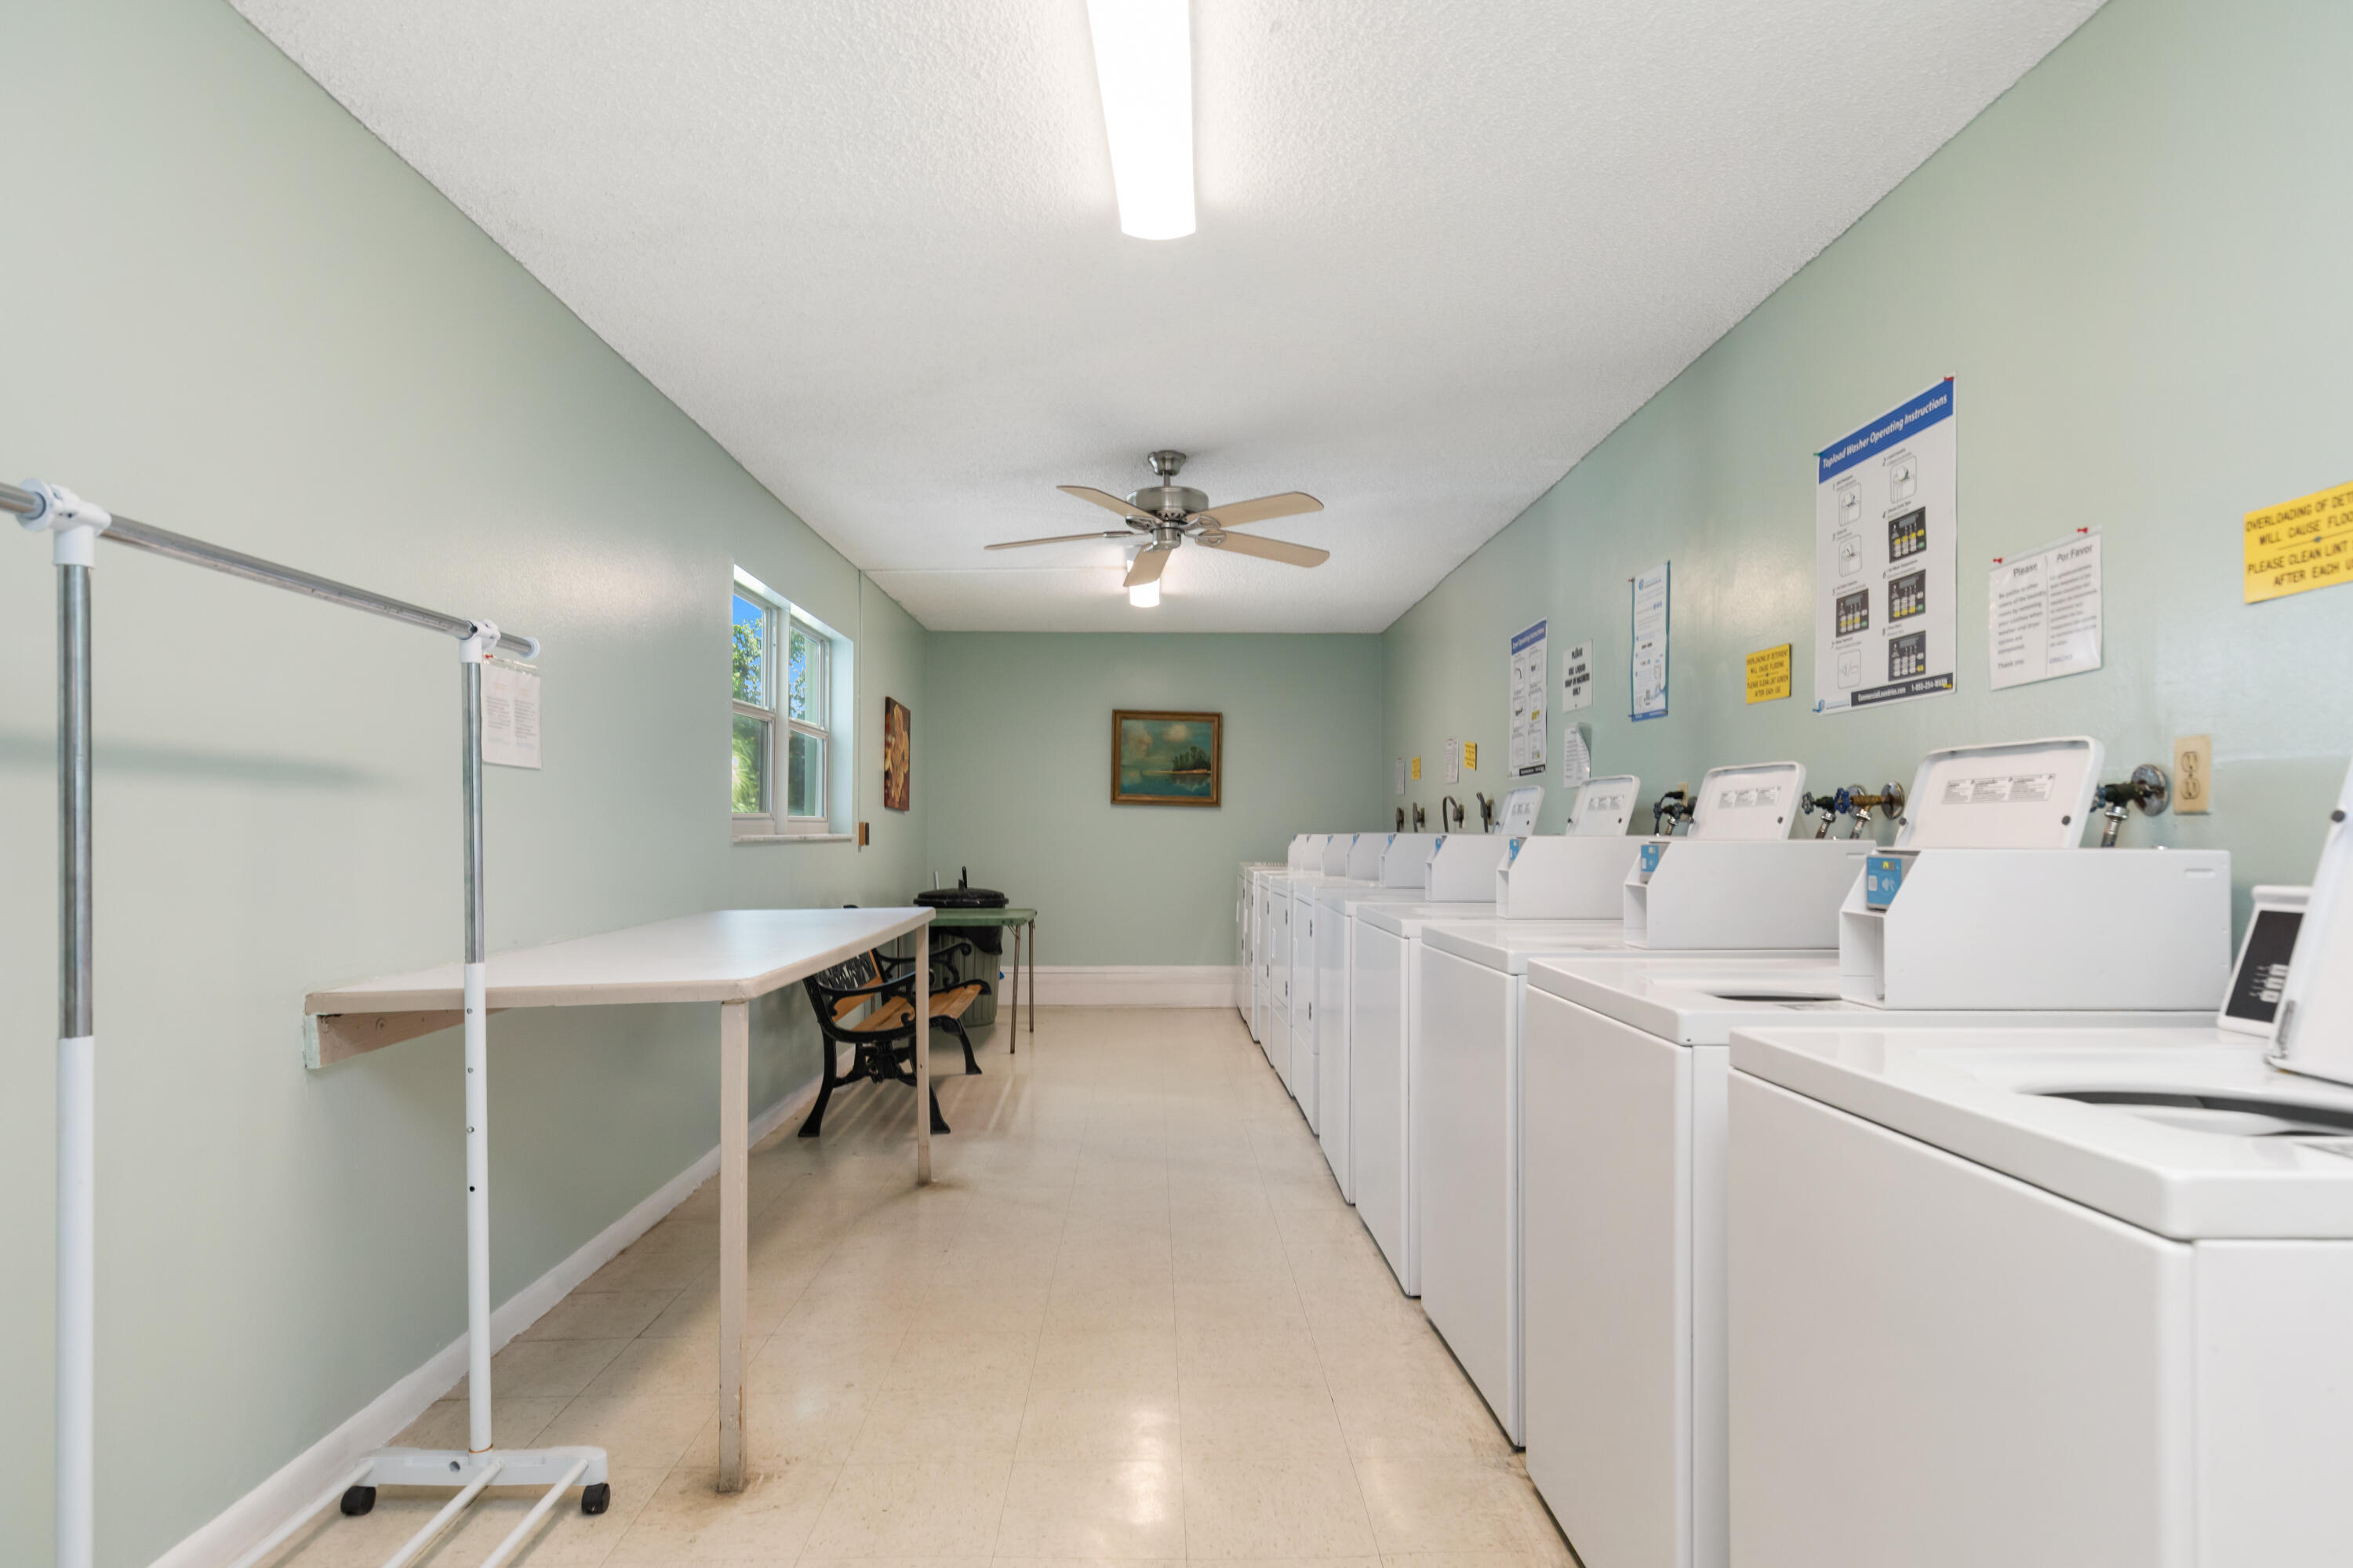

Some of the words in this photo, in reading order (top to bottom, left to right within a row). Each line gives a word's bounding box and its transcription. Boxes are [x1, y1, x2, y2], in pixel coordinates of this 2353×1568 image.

[1823, 447, 1847, 469] Topload
[1846, 437, 1869, 456] Washer
[1870, 417, 1904, 444] Operating
[1904, 394, 1947, 424] Instructions
[2246, 504, 2312, 532] OVERLOADING
[2315, 498, 2328, 513] OF
[2260, 532, 2282, 545] WILL
[2288, 519, 2322, 538] CAUSE
[2057, 552, 2069, 562] Por
[2071, 544, 2093, 558] Favor
[2248, 556, 2285, 574] PLEASE
[2289, 548, 2322, 565] CLEAN
[2325, 540, 2349, 556] LINT
[2013, 563, 2038, 577] Please
[2274, 569, 2307, 586] AFTER
[2312, 562, 2340, 578] EACH
